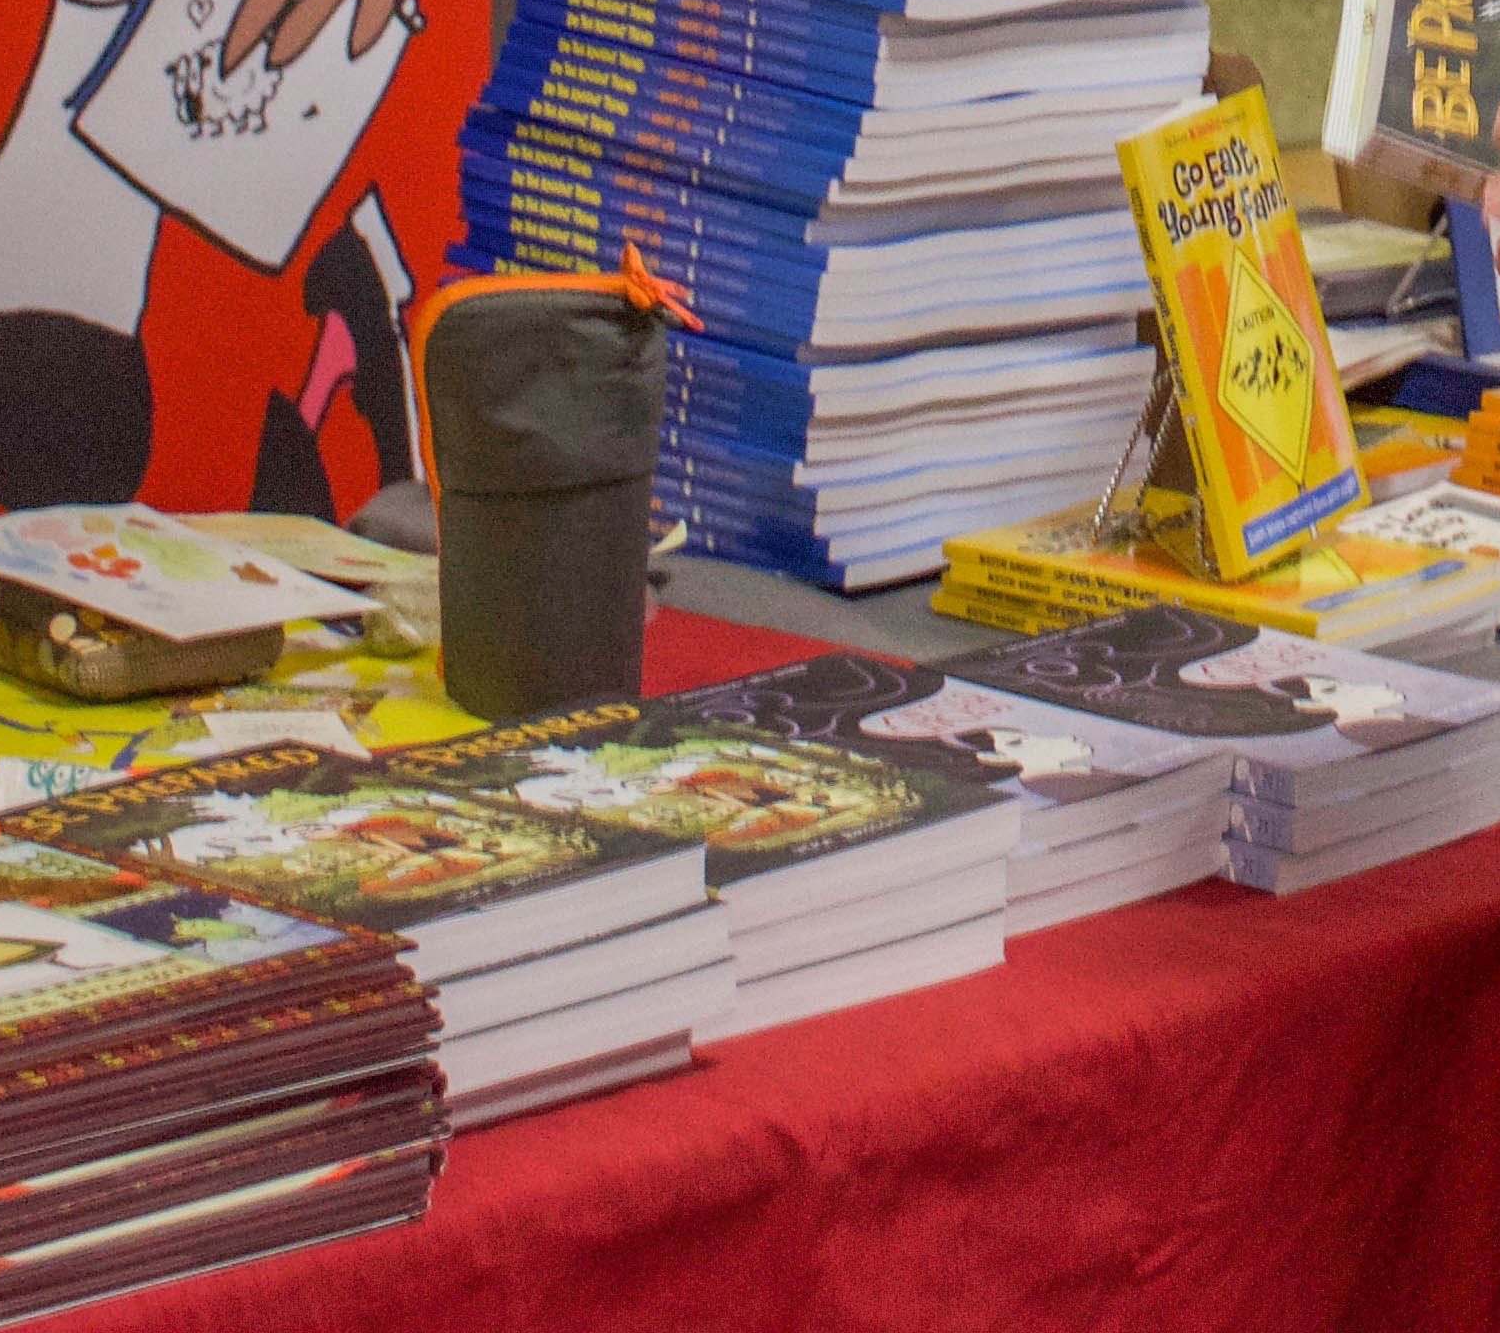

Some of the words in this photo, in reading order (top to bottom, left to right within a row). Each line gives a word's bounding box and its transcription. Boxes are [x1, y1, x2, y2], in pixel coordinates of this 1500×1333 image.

[1411, 46, 1480, 142] BE
[1172, 160, 1204, 200] Go
[1157, 191, 1242, 245] Young
